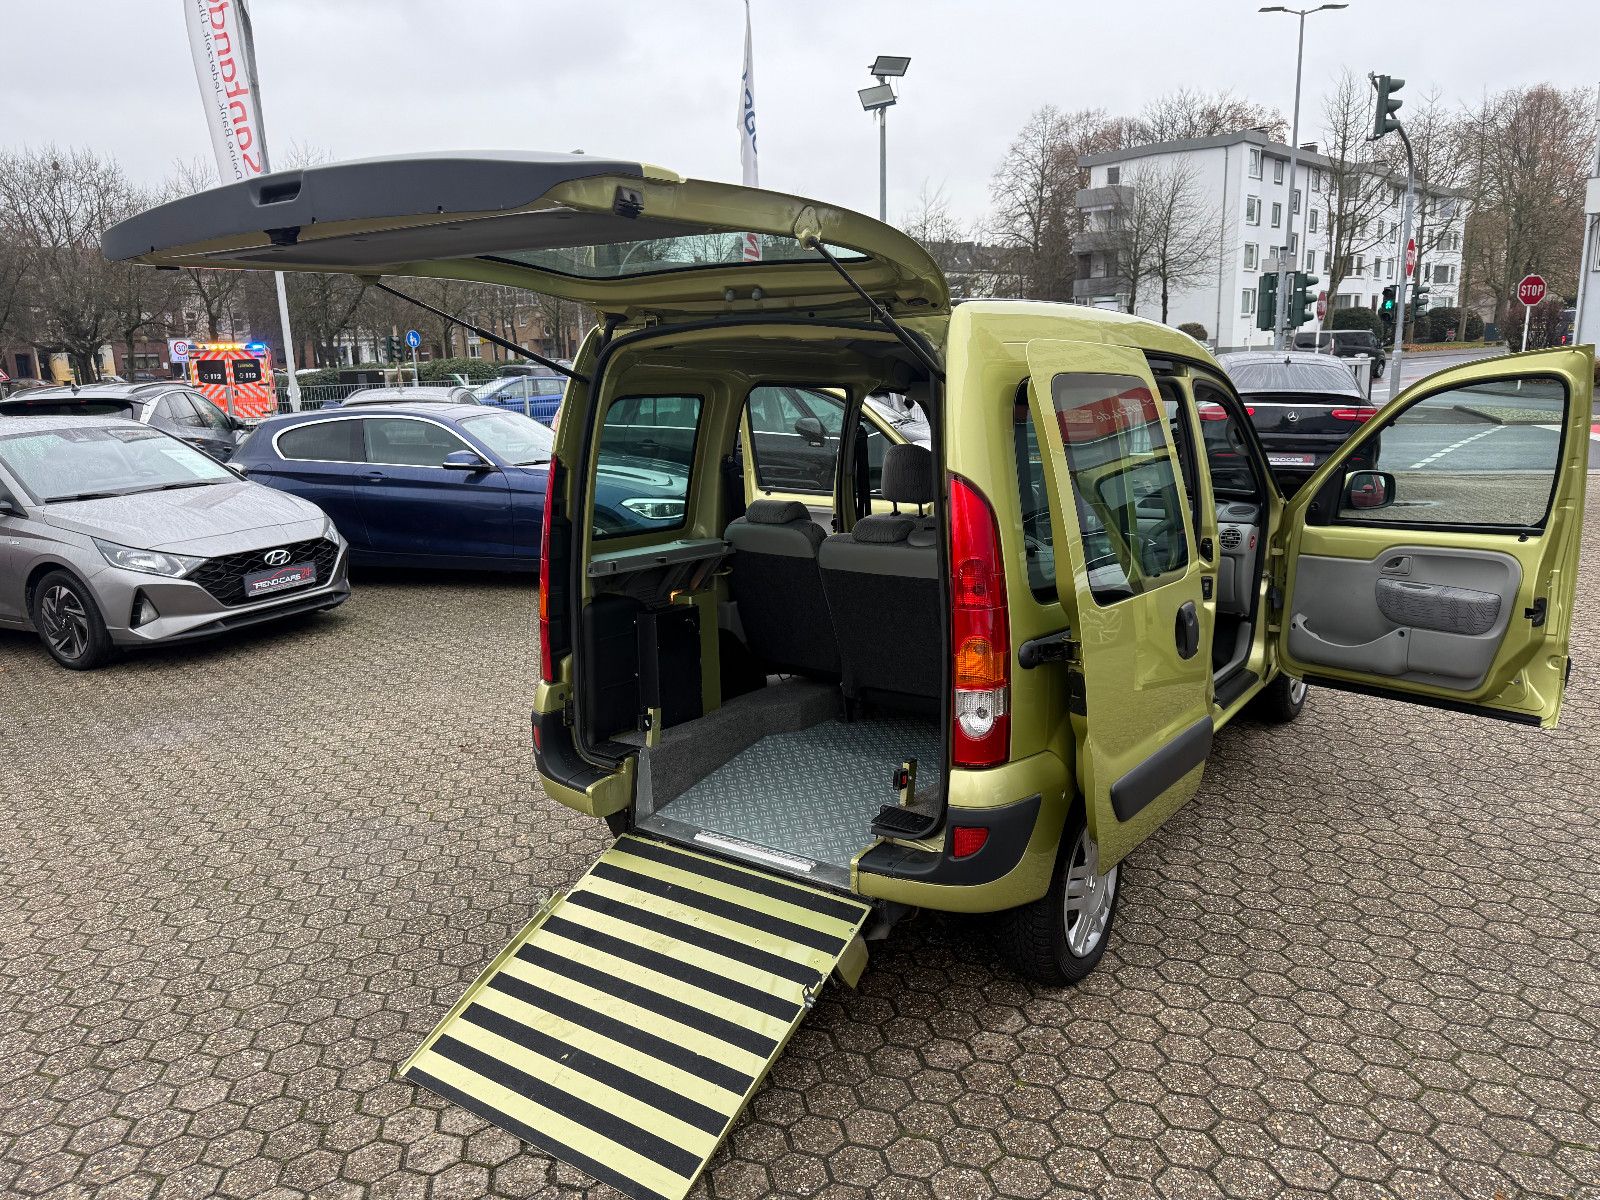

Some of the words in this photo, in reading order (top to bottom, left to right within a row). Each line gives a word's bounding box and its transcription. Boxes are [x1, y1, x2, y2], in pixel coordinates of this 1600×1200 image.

[1520, 284, 1544, 297] STOP
[177, 344, 186, 352] 30
[301, 566, 312, 580] 24
